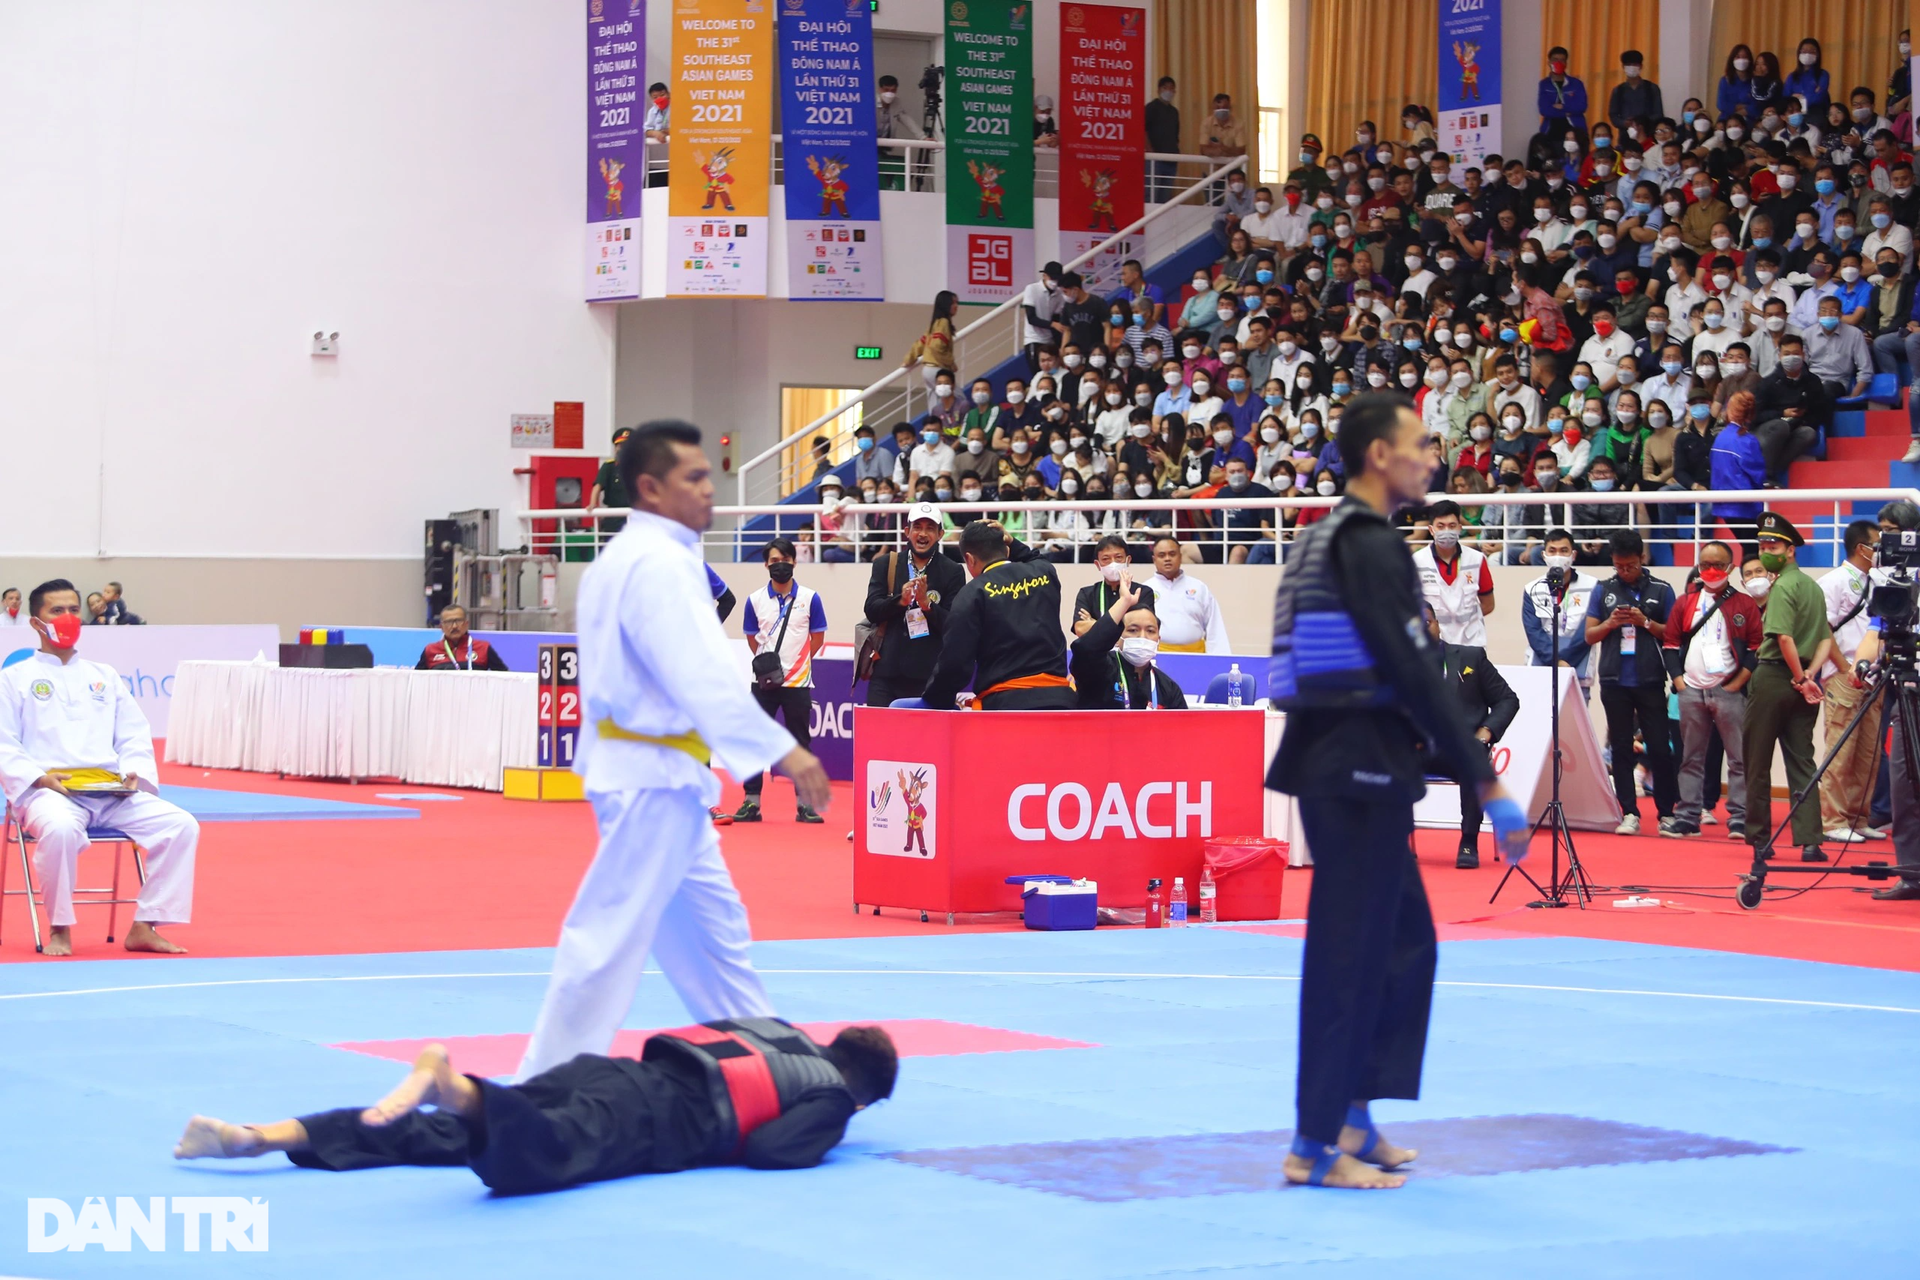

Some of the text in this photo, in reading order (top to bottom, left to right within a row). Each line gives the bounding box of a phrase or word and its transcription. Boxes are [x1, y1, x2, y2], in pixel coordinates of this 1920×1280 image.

[598, 21, 633, 38] ĐẠI HỘI
[681, 19, 755, 30] WELCOME TO
[799, 20, 851, 35] ĐẠI HỘI
[696, 36, 740, 48] THE 31st
[953, 32, 1019, 46] WELCOME TO
[1079, 38, 1127, 53] ĐẠI HỘI
[612, 41, 637, 54] THAO
[821, 42, 859, 52] THAO
[683, 54, 752, 65] SOUTHEAST
[791, 56, 861, 70] ĐÔNG NAM Á
[966, 50, 987, 62] THE
[593, 56, 637, 74] ĐÔNG NAM Á
[1099, 58, 1133, 71] THAO
[681, 69, 754, 81] ASIAN GAMES
[820, 74, 846, 87] THỨ
[848, 77, 859, 87] 31
[956, 66, 1016, 80] SOUTHEAST
[1070, 72, 1133, 88] ĐÔNG NAM Á
[628, 76, 635, 87] 31
[960, 82, 1013, 95] ASIAN GAMES
[595, 91, 635, 107] VIỆT NAM
[689, 89, 745, 100] VIET NAM
[795, 89, 861, 104] VIỆT NAM
[1121, 94, 1131, 105] 31
[691, 104, 742, 122] 2021
[962, 101, 1012, 114] VIET NAM
[1073, 104, 1132, 120] VIỆT NAM
[600, 107, 630, 127] 2021
[805, 106, 853, 125] 2021
[965, 116, 1010, 135] 2021
[1081, 121, 1124, 140] 2021
[972, 239, 1009, 259] JG
[972, 261, 1009, 282] BL
[857, 347, 880, 358] EXIT
[1905, 534, 1912, 544] 2
[984, 575, 1050, 599] Singapore
[541, 650, 552, 680] 3
[560, 651, 578, 680] 3
[540, 691, 552, 720] 2
[560, 692, 578, 720] 2
[808, 700, 853, 738] OAC
[541, 732, 549, 760] 1
[560, 732, 573, 761] 1
[1007, 781, 1212, 841] COACH
